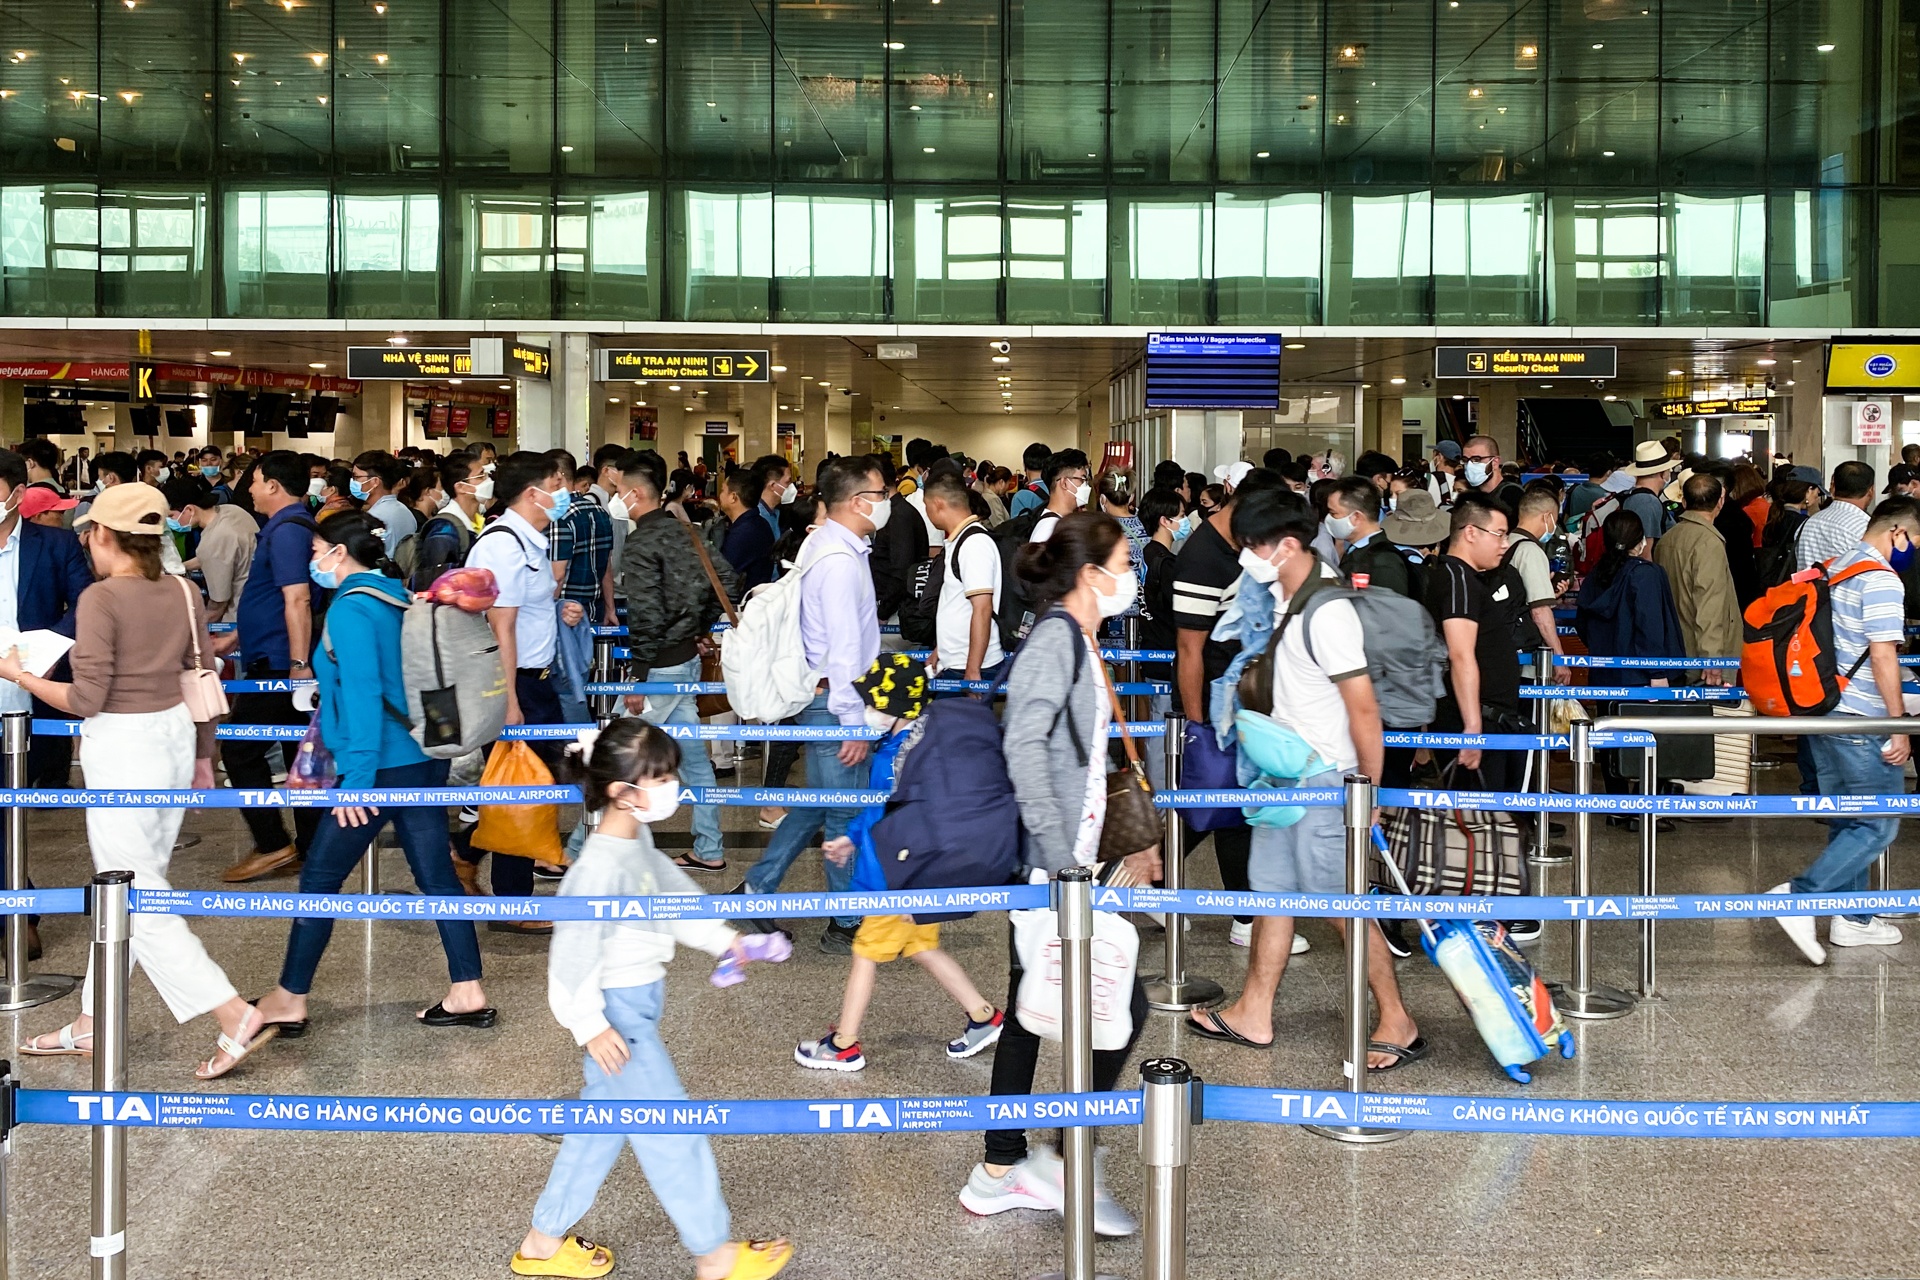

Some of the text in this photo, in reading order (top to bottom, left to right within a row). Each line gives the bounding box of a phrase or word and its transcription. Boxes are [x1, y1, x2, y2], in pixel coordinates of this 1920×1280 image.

[383, 352, 449, 364] NHÀ VỆ SINH
[616, 352, 707, 365] KIỂM TRA AN NINH
[1494, 350, 1584, 362] KIỂM TRA AN NINH
[91, 367, 129, 376] HÀNG/RO
[198, 368, 202, 380] K
[420, 365, 450, 374] Toilets
[642, 368, 708, 377] Security Check
[1493, 364, 1559, 374] Security Check
[138, 368, 152, 398] K
[247, 371, 257, 384] K-1
[263, 373, 274, 386] K-2
[1557, 626, 1578, 634] TIA
[1561, 656, 1588, 665] TIA
[256, 681, 287, 690] TIA
[674, 684, 702, 692] TIA
[740, 727, 764, 736] CẢNG
[766, 728, 790, 736] HÀNG
[793, 728, 823, 736] KHÔNG
[825, 727, 849, 737] QUỐC
[852, 727, 863, 736] TẾ
[1385, 734, 1410, 743] QUỐC
[1412, 734, 1423, 743] TẾ
[1425, 735, 1441, 744] TÂN
[1464, 735, 1486, 744] NHẤT
[16, 792, 205, 804] KHÔNG QUỐC TẾ TÂN SƠN NHẤT
[239, 791, 285, 804] TIA
[336, 790, 569, 802] TAN SON NHAT INTERNATIONAL AIRPORT
[755, 791, 857, 803] CẢNG HÀNG KHÔNG
[1174, 792, 1338, 802] NHAT INTERNATIONAL AIRPORT
[1408, 792, 1453, 806] TIA
[1504, 795, 1757, 809] CẢNG HÀNG KHÔNG QUỐC TẾ TÂN SƠN NHẤT
[1791, 797, 1836, 810] TIA
[202, 895, 541, 915] CẢNG HÀNG KHÔNG QUỐC TẾ TÂN SƠN NHẤT
[713, 892, 1010, 912] TAN SON NHAT INTERNATIONAL AIRPORT
[1196, 894, 1493, 913] CẢNG HÀNG KHÔNG QUỐC TẾ TÂN SƠN NHẤT
[1564, 899, 1622, 916] TIA
[1695, 897, 1905, 911] TAN SON NHAT INTERNATIONAL
[588, 901, 646, 917] TIA
[68, 1096, 152, 1120] TIA
[162, 1107, 235, 1115] INTERNATIONAL
[249, 1098, 730, 1124] CẢNG HÀNG KHÔNG QUỐC TẾ TÂN SƠN NHẤT
[987, 1099, 1140, 1119] TAN SON NHAT
[1273, 1094, 1347, 1119] TIA
[1363, 1104, 1432, 1116] INTERNATIONAL
[809, 1104, 892, 1127] TIA
[1363, 1115, 1401, 1123] AIRPORT
[1453, 1101, 1870, 1126] CẢNG HÀNG KHÔNG QUỐC TẾ TÂN SƠN NHẤT
